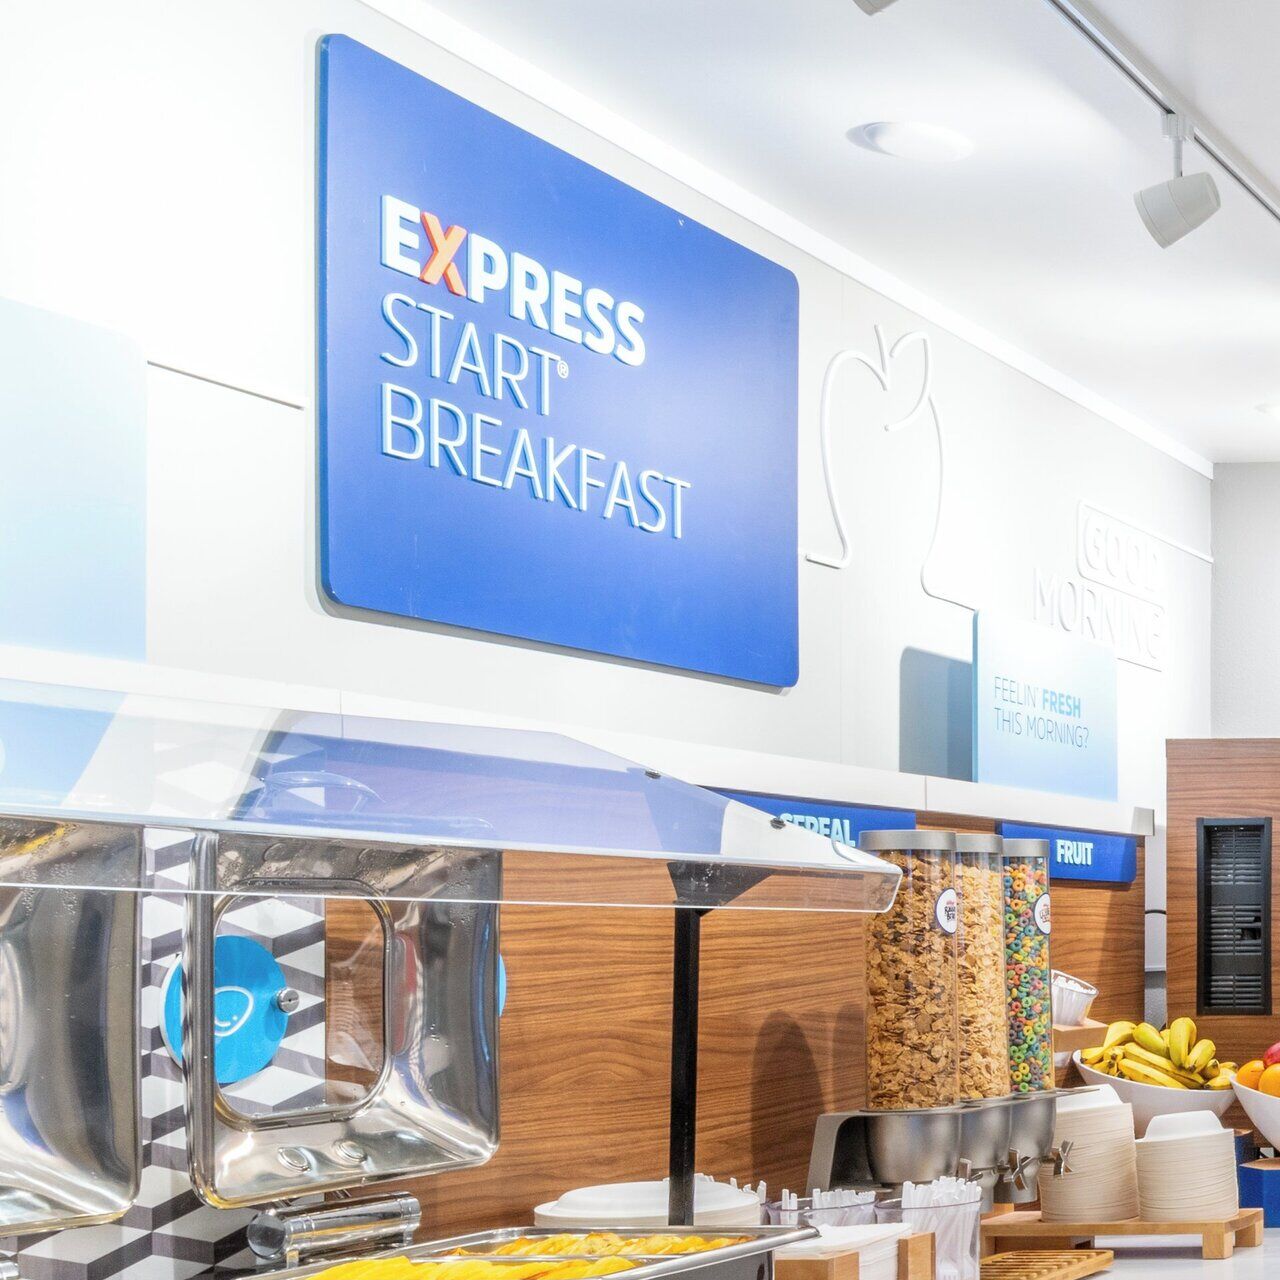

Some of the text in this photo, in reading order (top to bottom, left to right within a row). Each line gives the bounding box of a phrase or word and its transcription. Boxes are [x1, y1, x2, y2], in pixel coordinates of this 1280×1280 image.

[381, 194, 647, 367] EXPRESS
[381, 382, 692, 539] BREAKFAST
[1041, 687, 1082, 719] FRESH
[993, 706, 1089, 749] THIS MORNING?
[1056, 838, 1094, 867] FRUIT
